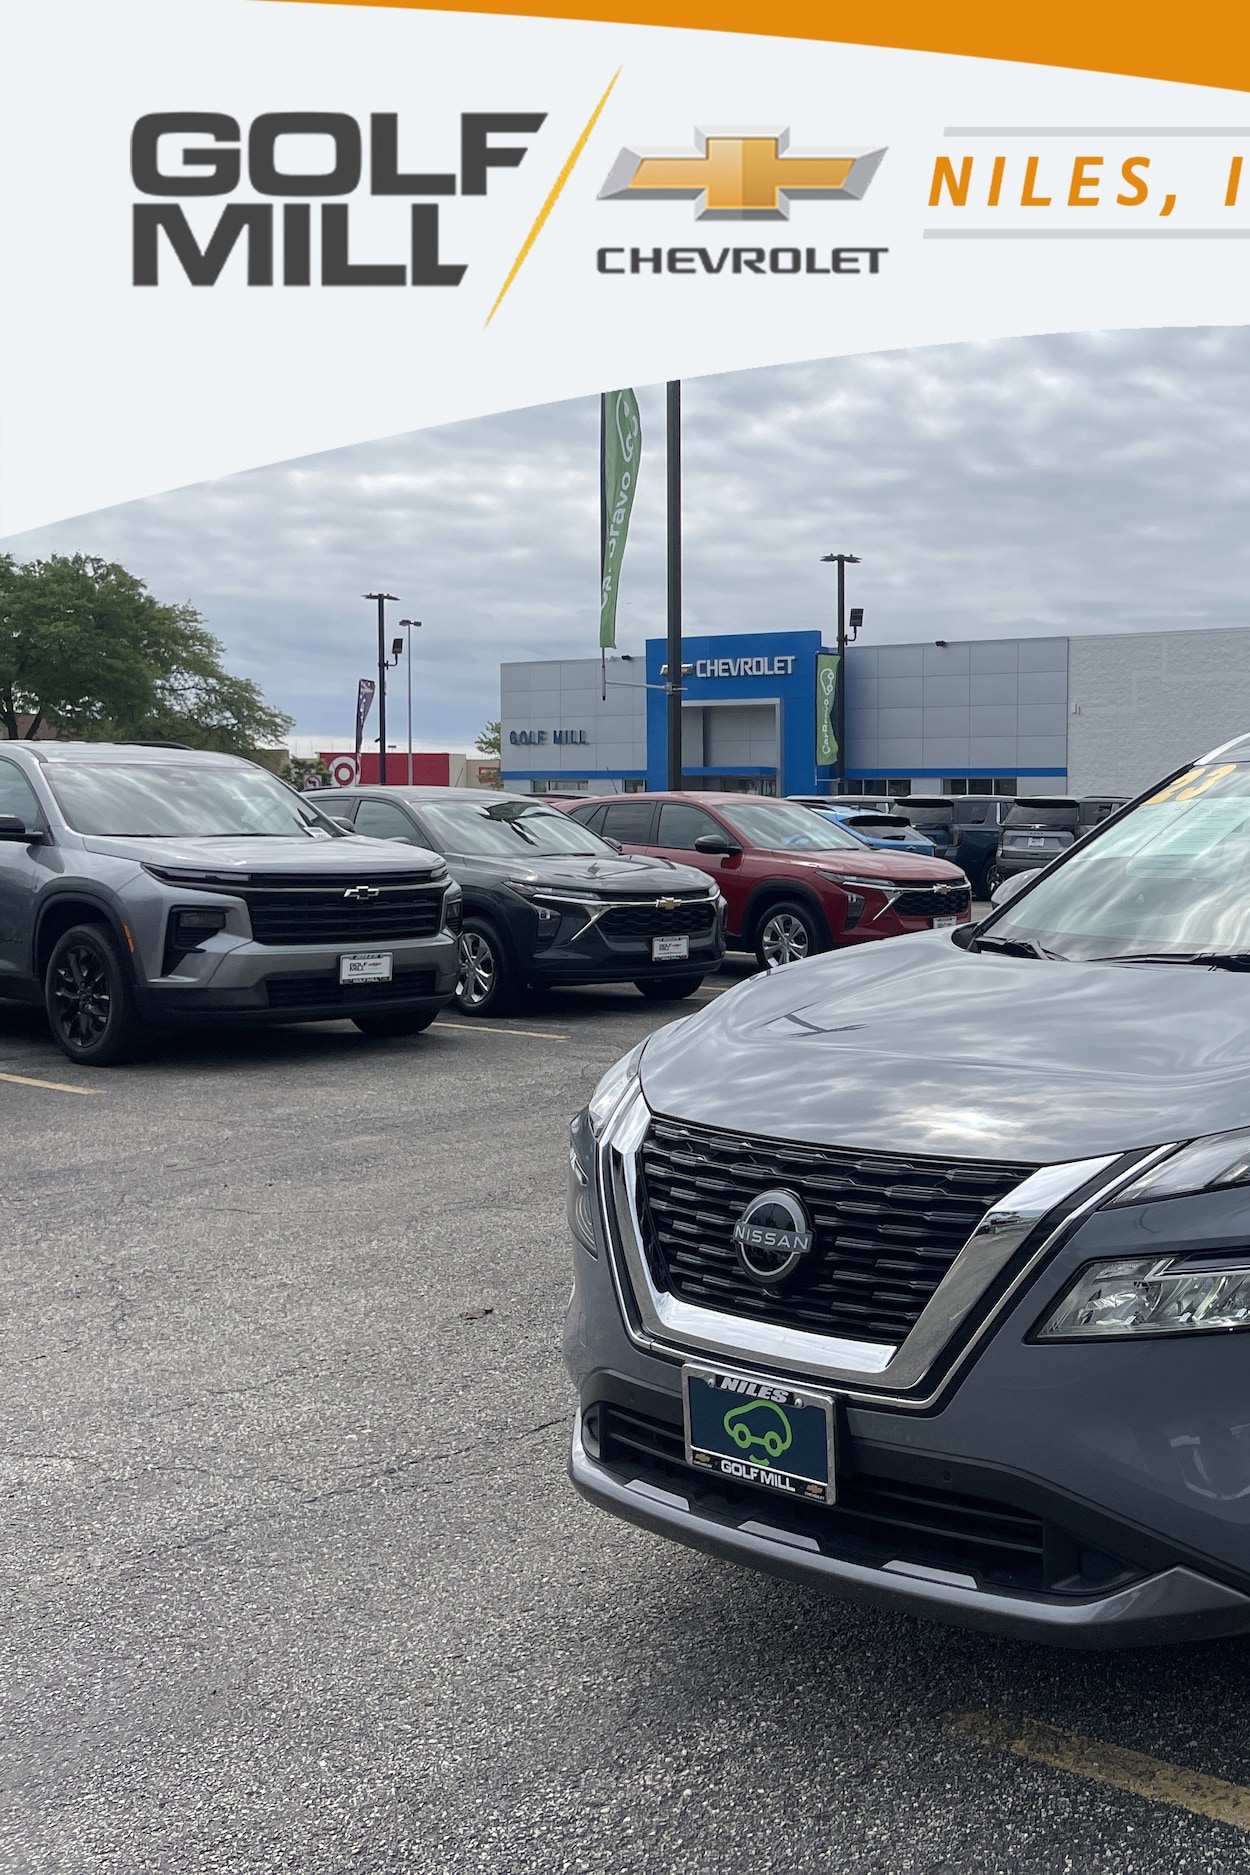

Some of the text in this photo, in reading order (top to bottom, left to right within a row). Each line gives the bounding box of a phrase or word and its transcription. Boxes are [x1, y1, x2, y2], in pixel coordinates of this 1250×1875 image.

[696, 655, 796, 678] CHEVROLET
[509, 729, 587, 746] GOLF MILL
[734, 1225, 809, 1250] NISSAN
[720, 1376, 790, 1404] NILES
[720, 1459, 796, 1493] GOLF MILL
